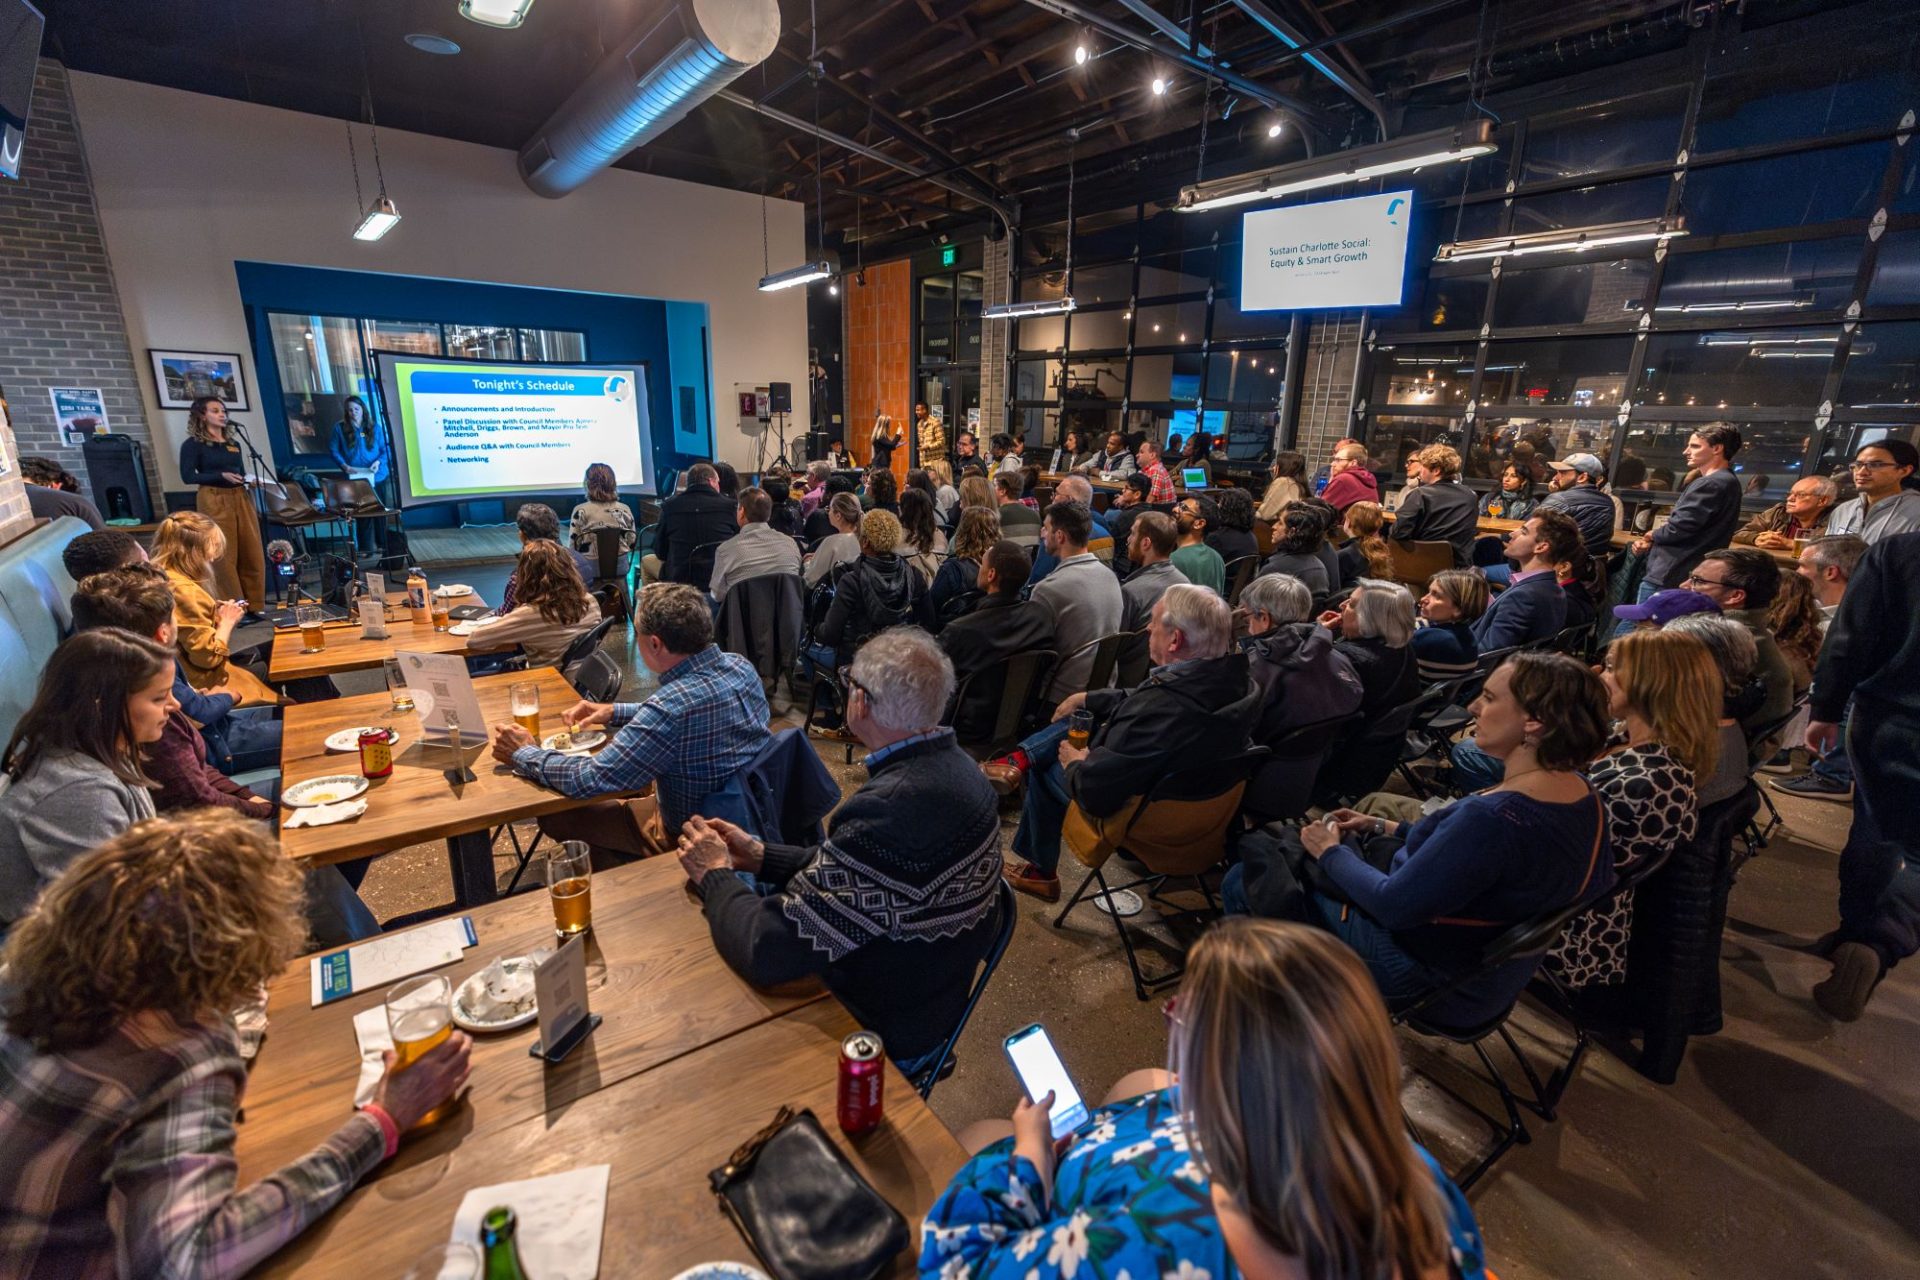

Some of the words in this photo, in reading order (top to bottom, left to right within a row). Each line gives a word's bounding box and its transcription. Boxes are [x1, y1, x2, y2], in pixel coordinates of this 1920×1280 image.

[1269, 246, 1298, 256] Sustain
[1300, 242, 1339, 253] Charlotte
[1342, 238, 1371, 249] Social:
[1270, 258, 1295, 268] Equity
[1298, 256, 1304, 265] &
[1306, 255, 1331, 264] Smart
[1334, 251, 1368, 262] Growth
[527, 381, 575, 391] Schedule
